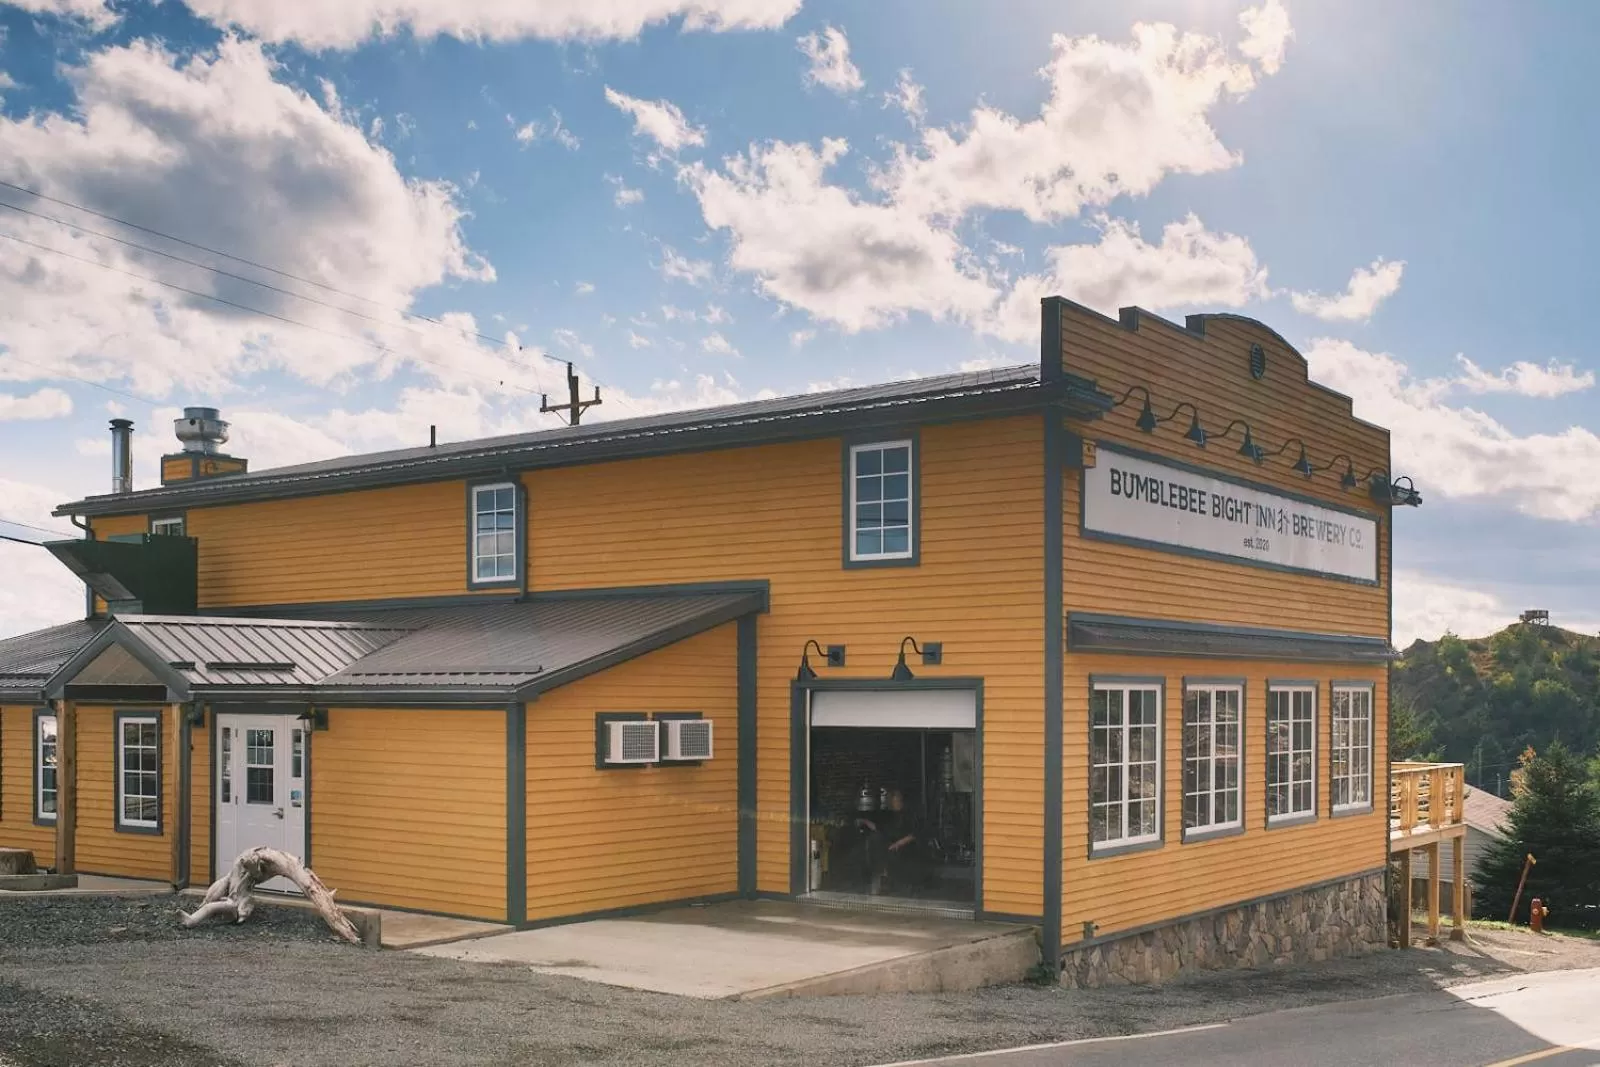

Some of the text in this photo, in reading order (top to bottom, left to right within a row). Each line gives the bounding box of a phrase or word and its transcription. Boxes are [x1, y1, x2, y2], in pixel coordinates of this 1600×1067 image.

[1110, 467, 1207, 515] BUMBLEBEE
[1212, 494, 1252, 525] BIGHT
[1255, 503, 1276, 530] INN
[1292, 513, 1347, 546] BREWERY
